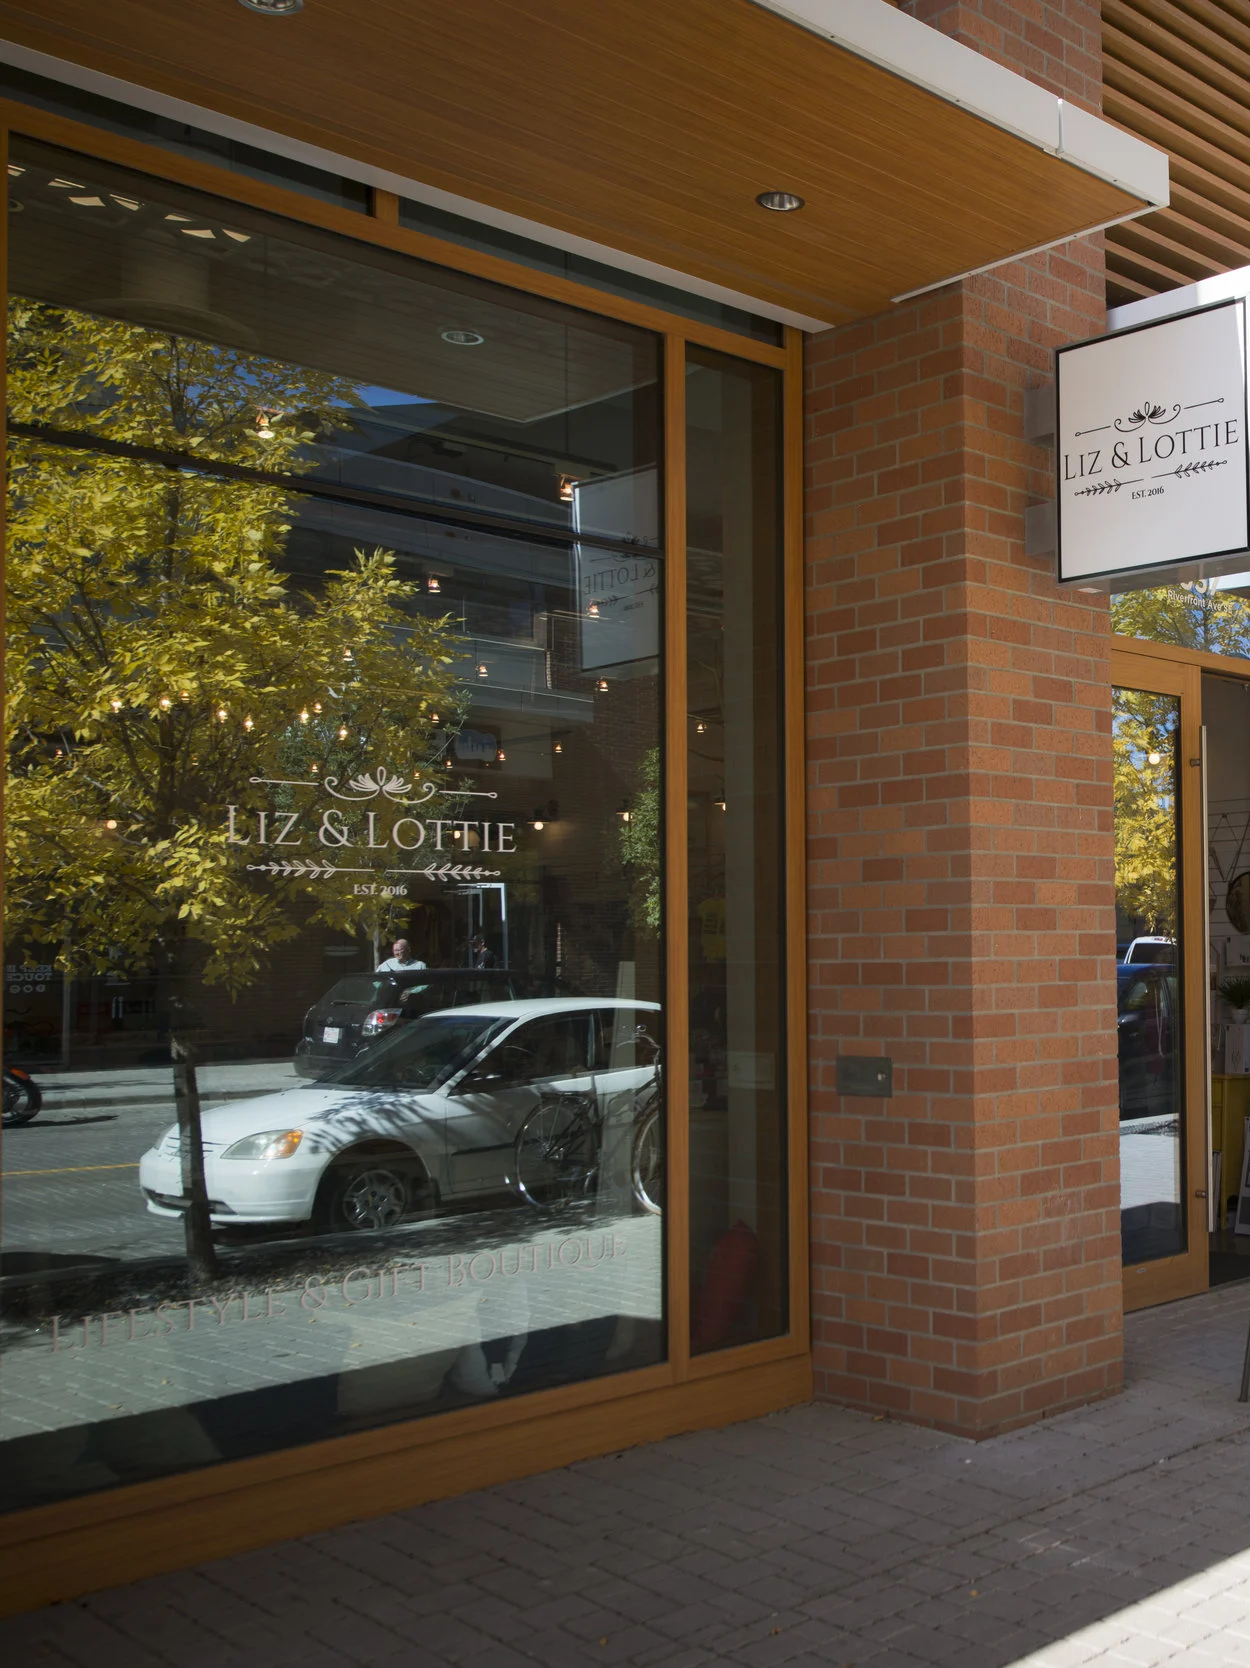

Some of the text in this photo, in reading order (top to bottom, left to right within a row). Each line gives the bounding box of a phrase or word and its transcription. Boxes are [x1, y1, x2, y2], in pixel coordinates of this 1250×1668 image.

[1063, 419, 1239, 481] LIZ & LOTTIE
[1131, 486, 1165, 500] EST. 2016
[1167, 589, 1205, 607] Riverfront
[1207, 599, 1222, 612] Ave
[225, 805, 518, 853] LIZ & LOTTIE
[353, 884, 408, 897] EST. 2016
[49, 1231, 629, 1354] LIFESTYLE & GIFT BOUTIQUE
